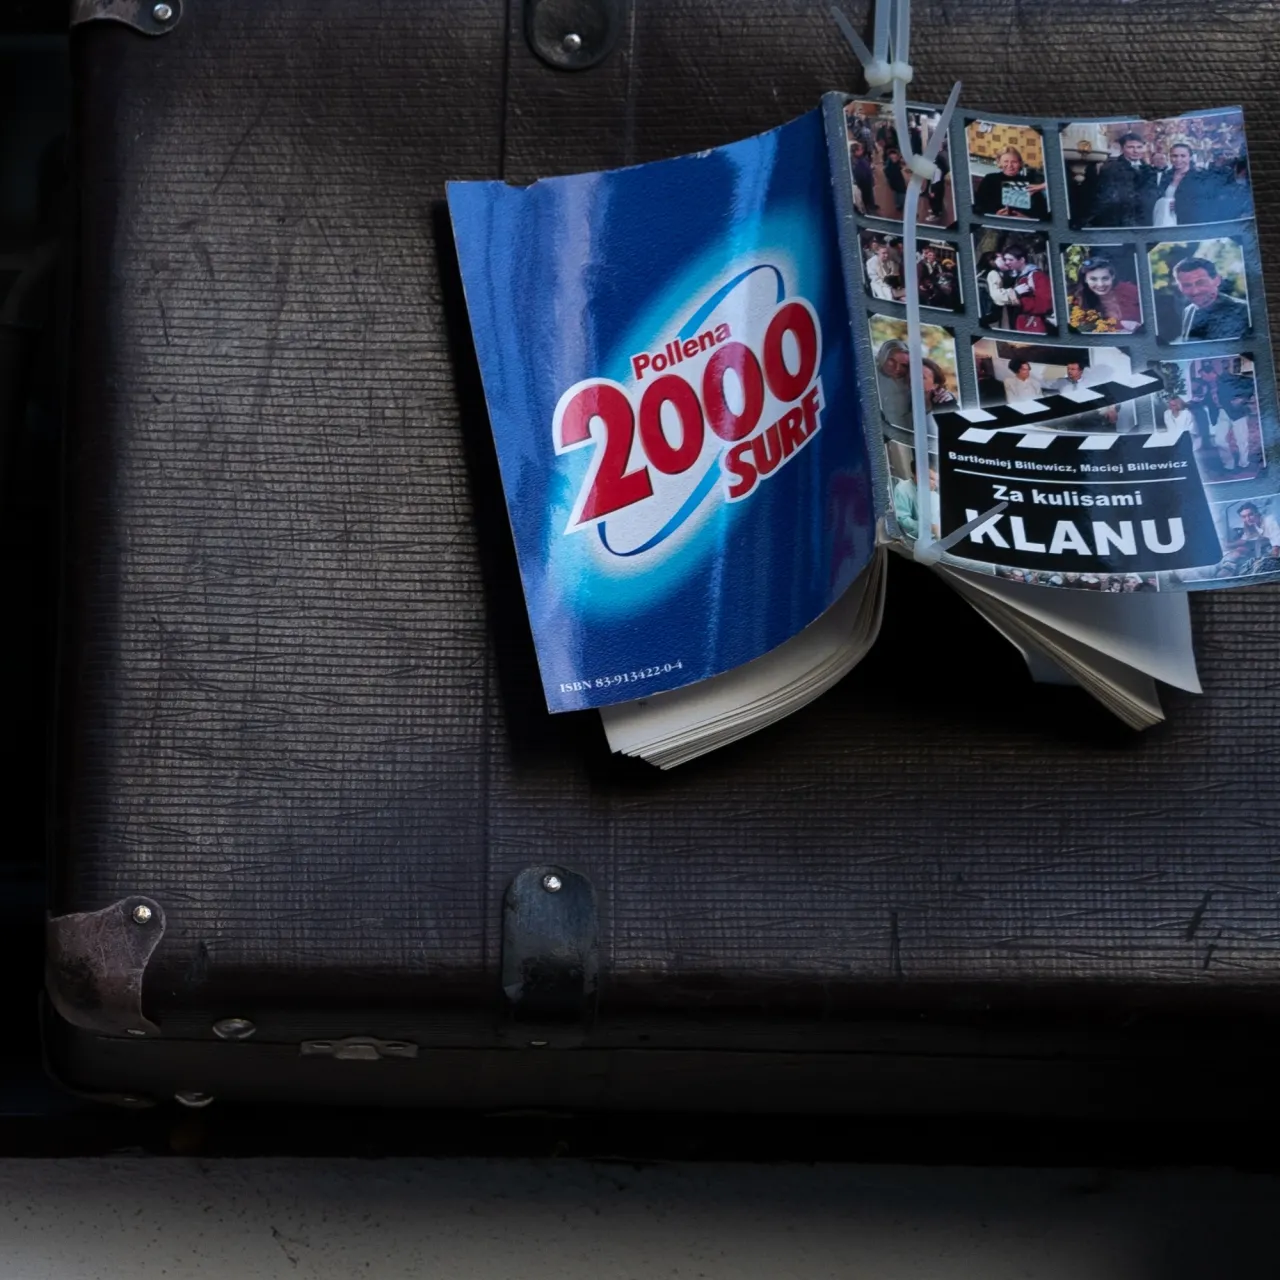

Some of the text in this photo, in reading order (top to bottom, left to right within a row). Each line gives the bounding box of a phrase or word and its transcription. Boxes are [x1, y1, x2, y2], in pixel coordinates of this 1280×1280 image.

[630, 321, 732, 381] Pollena
[559, 302, 818, 527] 2000
[723, 386, 824, 501] SURF
[948, 451, 1188, 473] Bartłomiej Billewicz, Maciej Billewicz
[993, 484, 1142, 506] Za kulisami
[964, 508, 1185, 557] KLANU
[560, 680, 592, 693] ISBN
